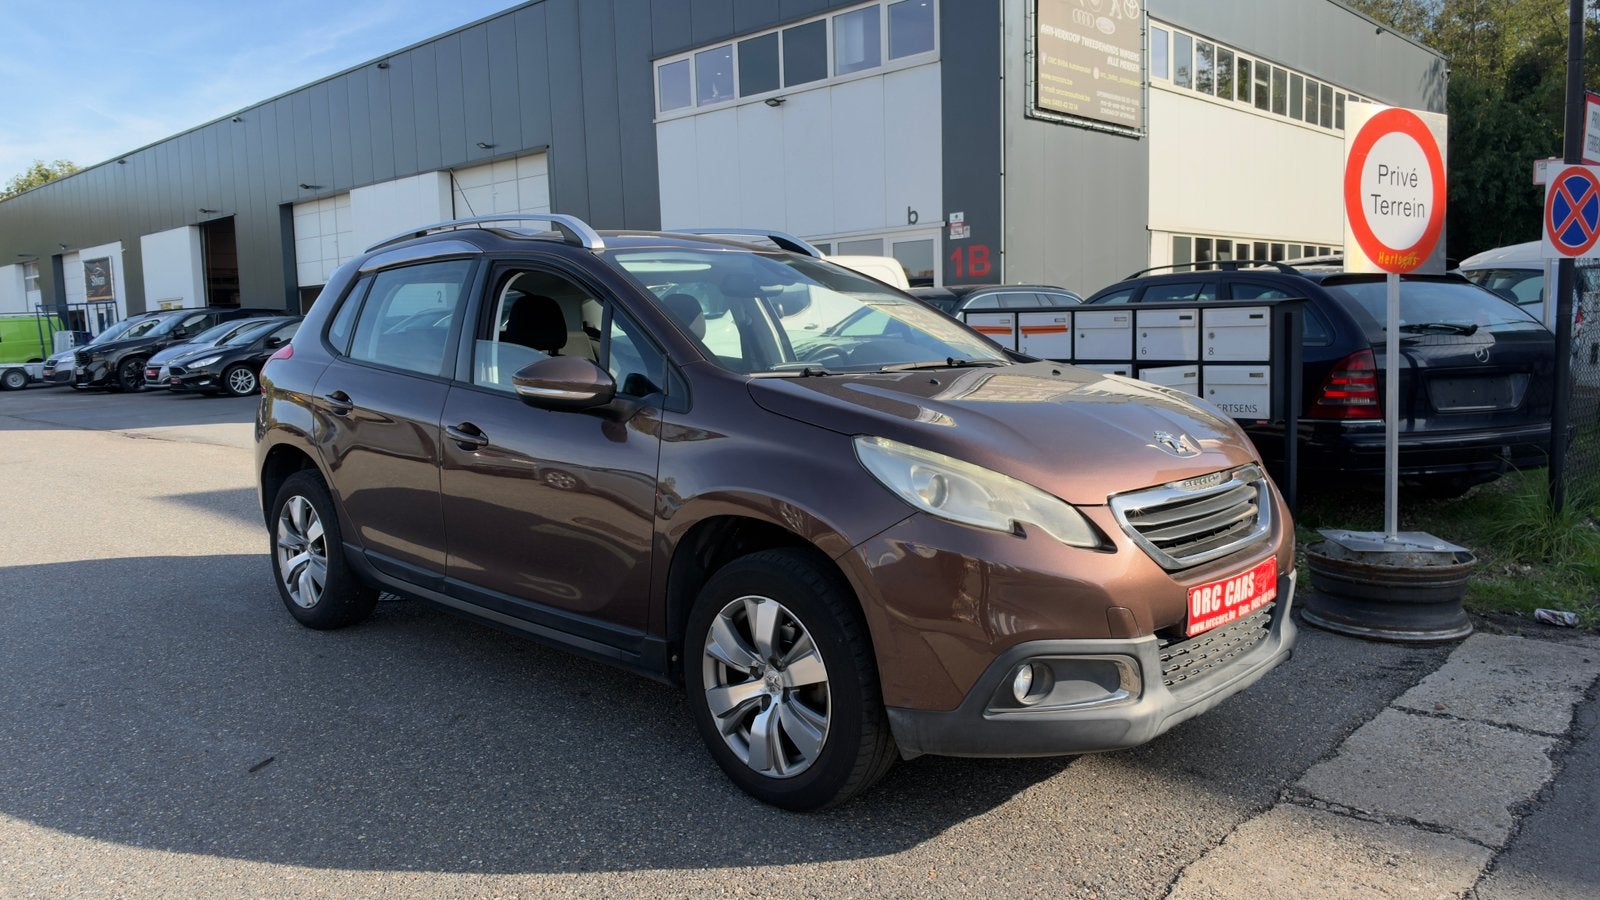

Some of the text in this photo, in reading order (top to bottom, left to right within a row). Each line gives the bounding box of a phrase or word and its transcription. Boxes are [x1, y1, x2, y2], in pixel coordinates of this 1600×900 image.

[1378, 164, 1418, 188] Privé
[907, 206, 919, 225] b
[1370, 193, 1425, 218] Terrein
[950, 244, 992, 278] 1B
[1141, 347, 1147, 355] 6
[1208, 347, 1214, 355] 8
[1216, 403, 1258, 413] ERTSENS
[1192, 584, 1222, 618] ORC
[1224, 571, 1255, 607] CARS
